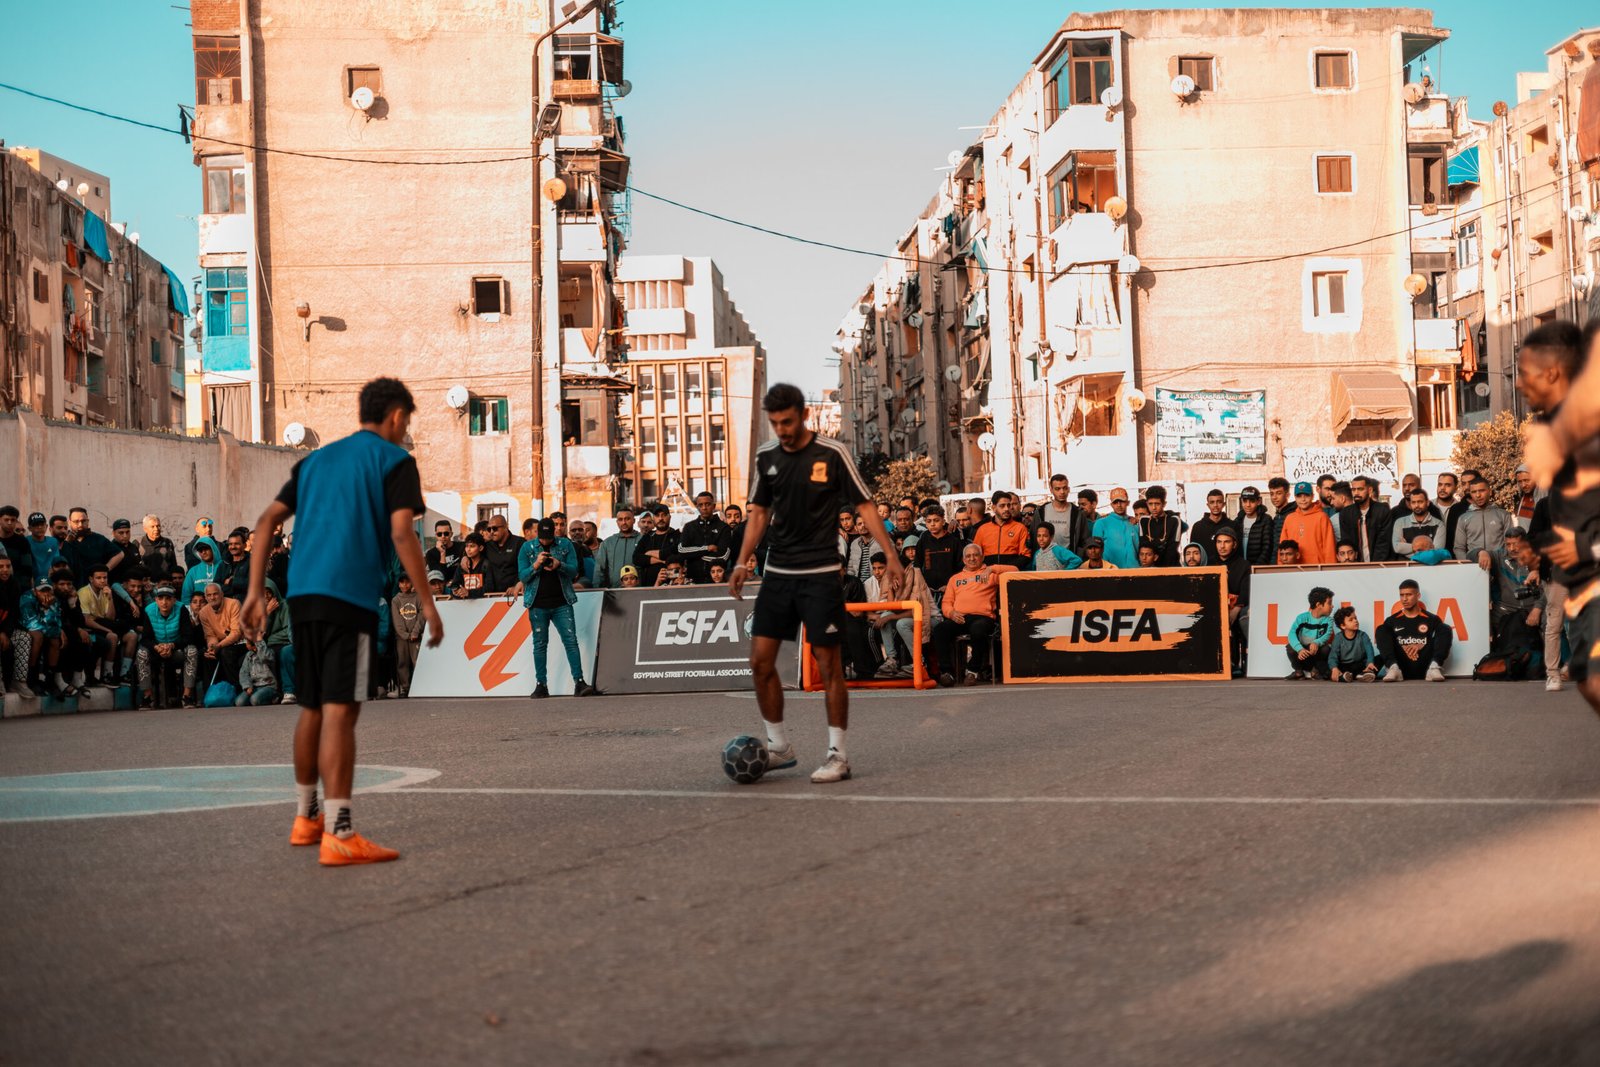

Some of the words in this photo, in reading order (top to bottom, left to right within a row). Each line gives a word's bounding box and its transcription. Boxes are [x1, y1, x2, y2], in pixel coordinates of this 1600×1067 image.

[655, 609, 739, 645] ESFA
[1070, 608, 1162, 643] ISFA
[1397, 636, 1427, 645] indeed
[685, 670, 715, 678] FOOTBALL
[716, 669, 753, 677] ASSOCIATIO
